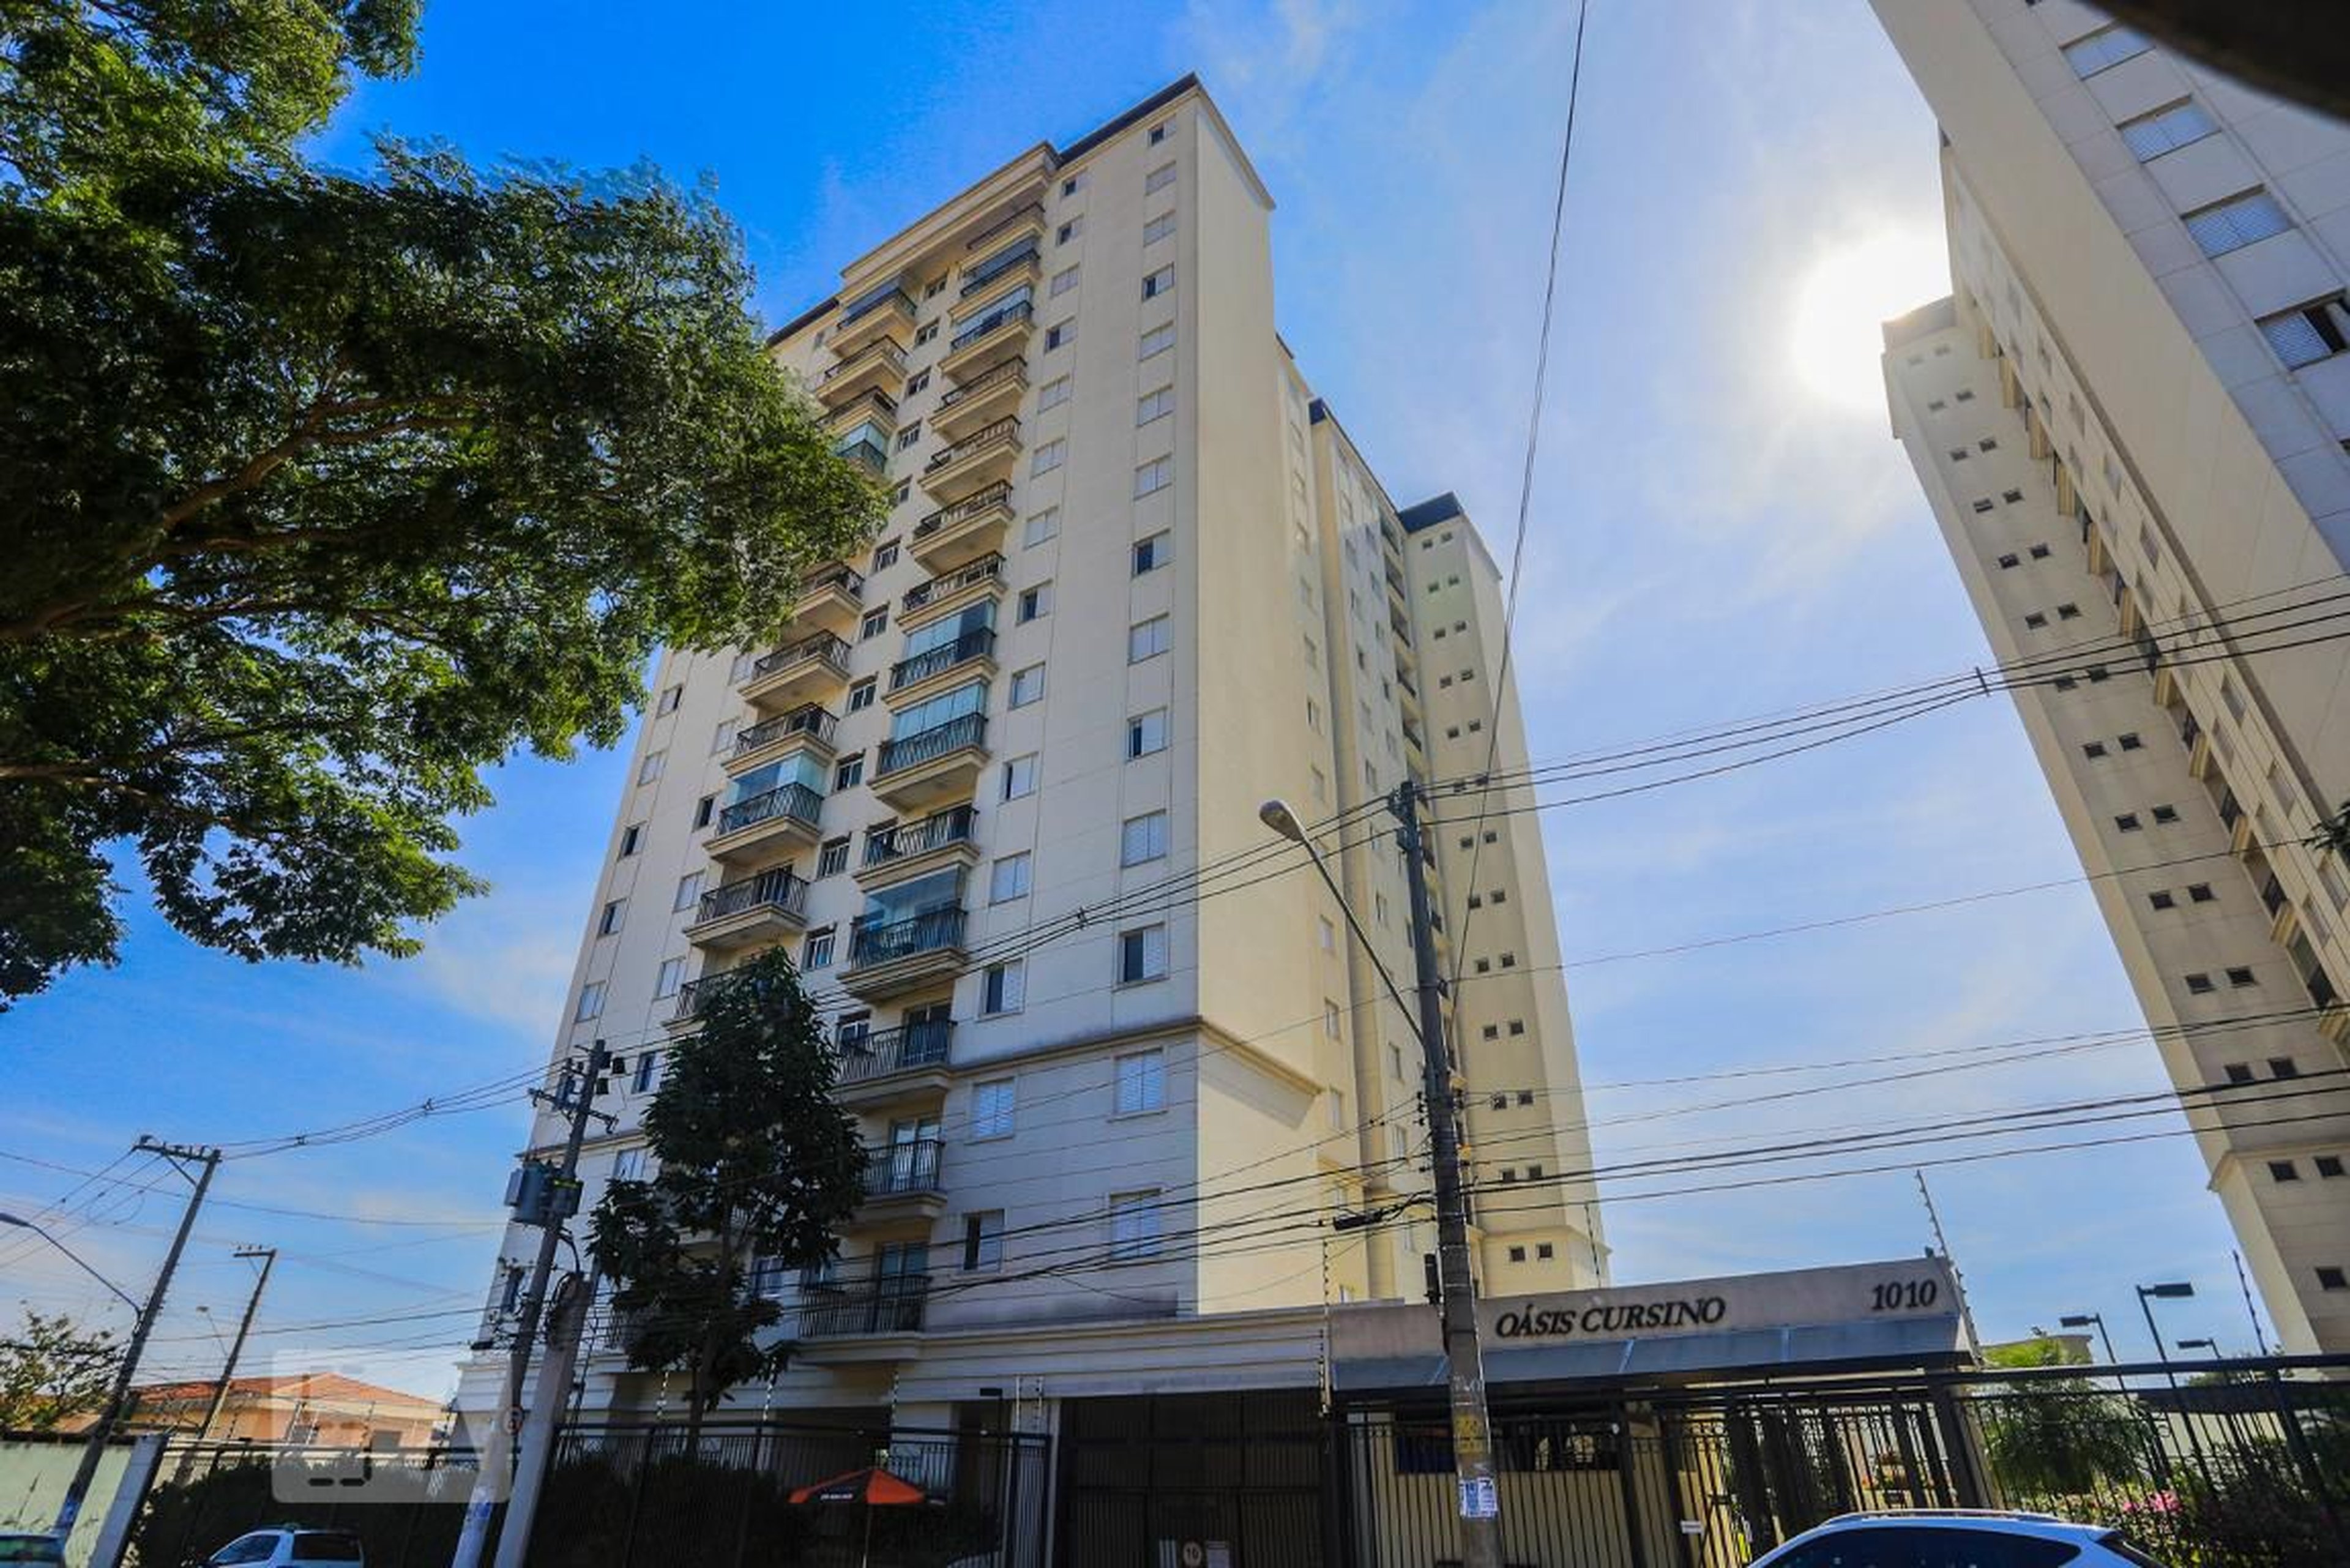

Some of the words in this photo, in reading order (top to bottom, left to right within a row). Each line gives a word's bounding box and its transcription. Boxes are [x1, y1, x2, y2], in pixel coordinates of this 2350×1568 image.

[1871, 1279, 1937, 1310] 1010
[1495, 1305, 1575, 1338] OÁSIS
[1581, 1297, 1726, 1332] CURSINO
